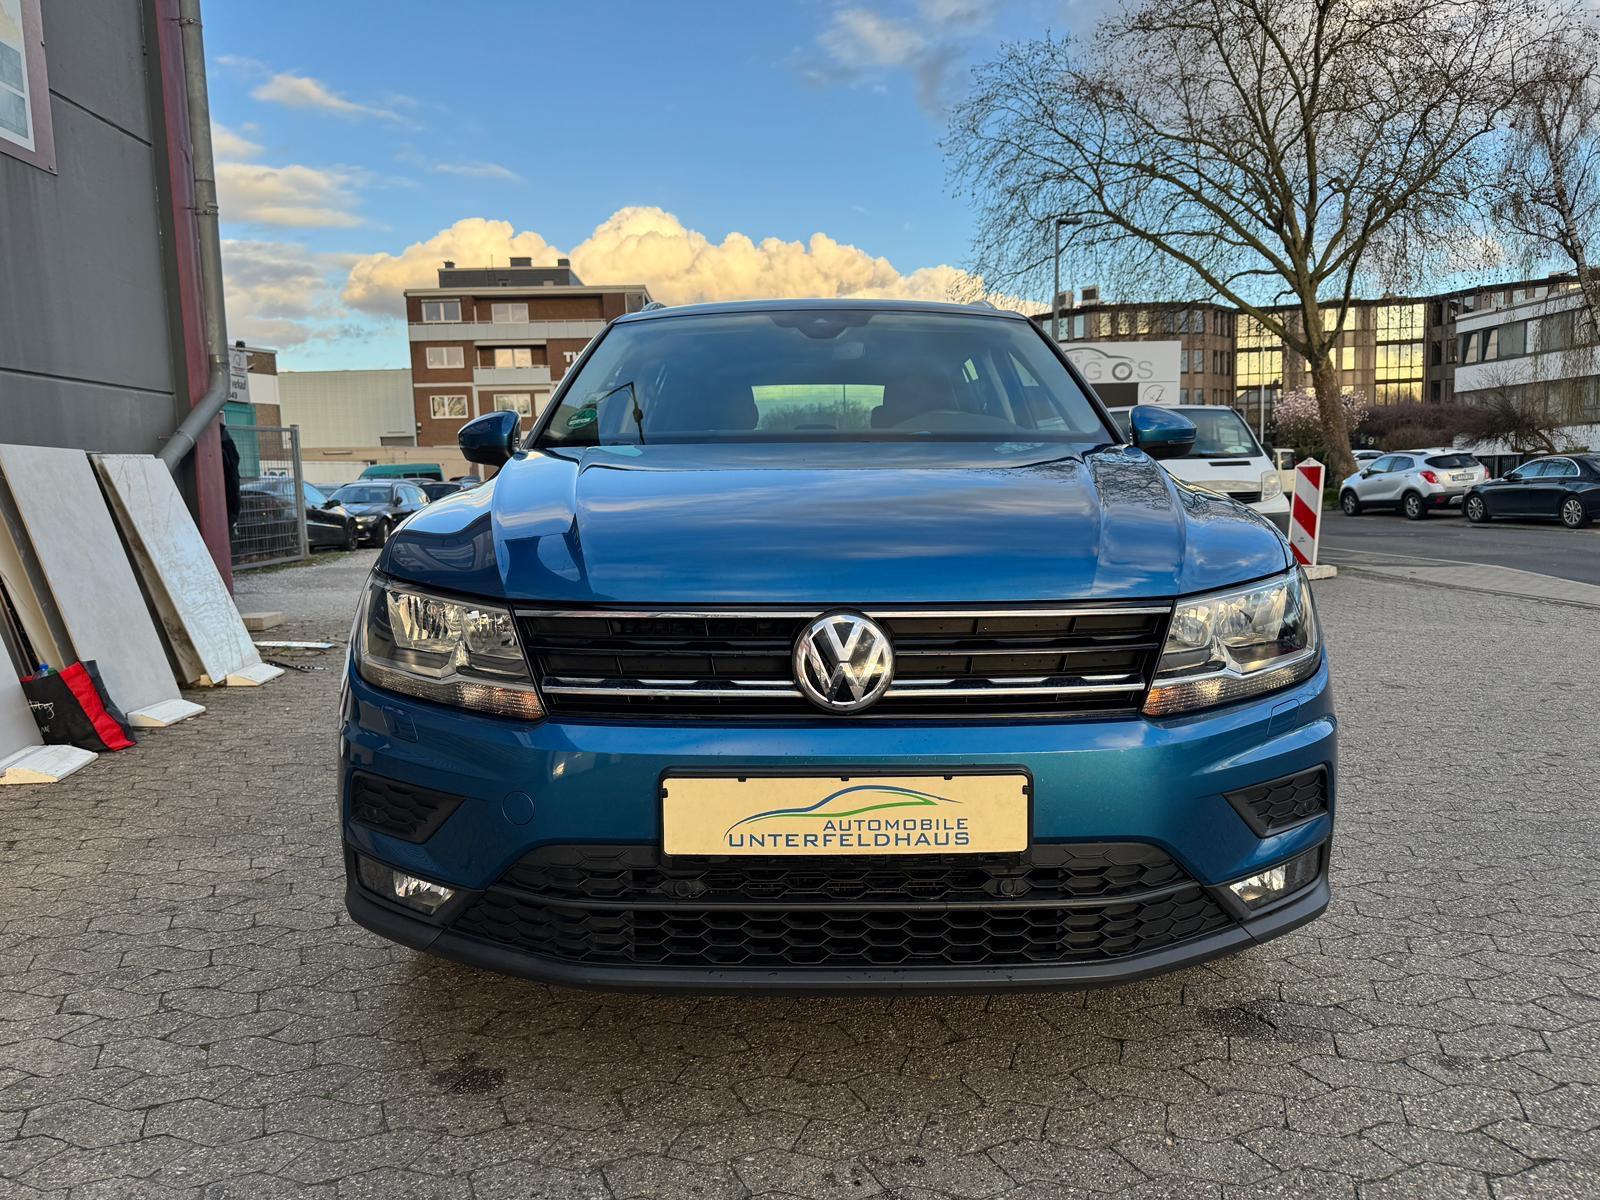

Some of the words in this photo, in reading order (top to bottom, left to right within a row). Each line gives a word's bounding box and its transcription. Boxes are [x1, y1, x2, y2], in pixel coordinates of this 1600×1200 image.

[796, 614, 893, 710] VW
[823, 818, 969, 832] AUTOMOBILE
[728, 832, 970, 847] UNTERFELDHAUS
